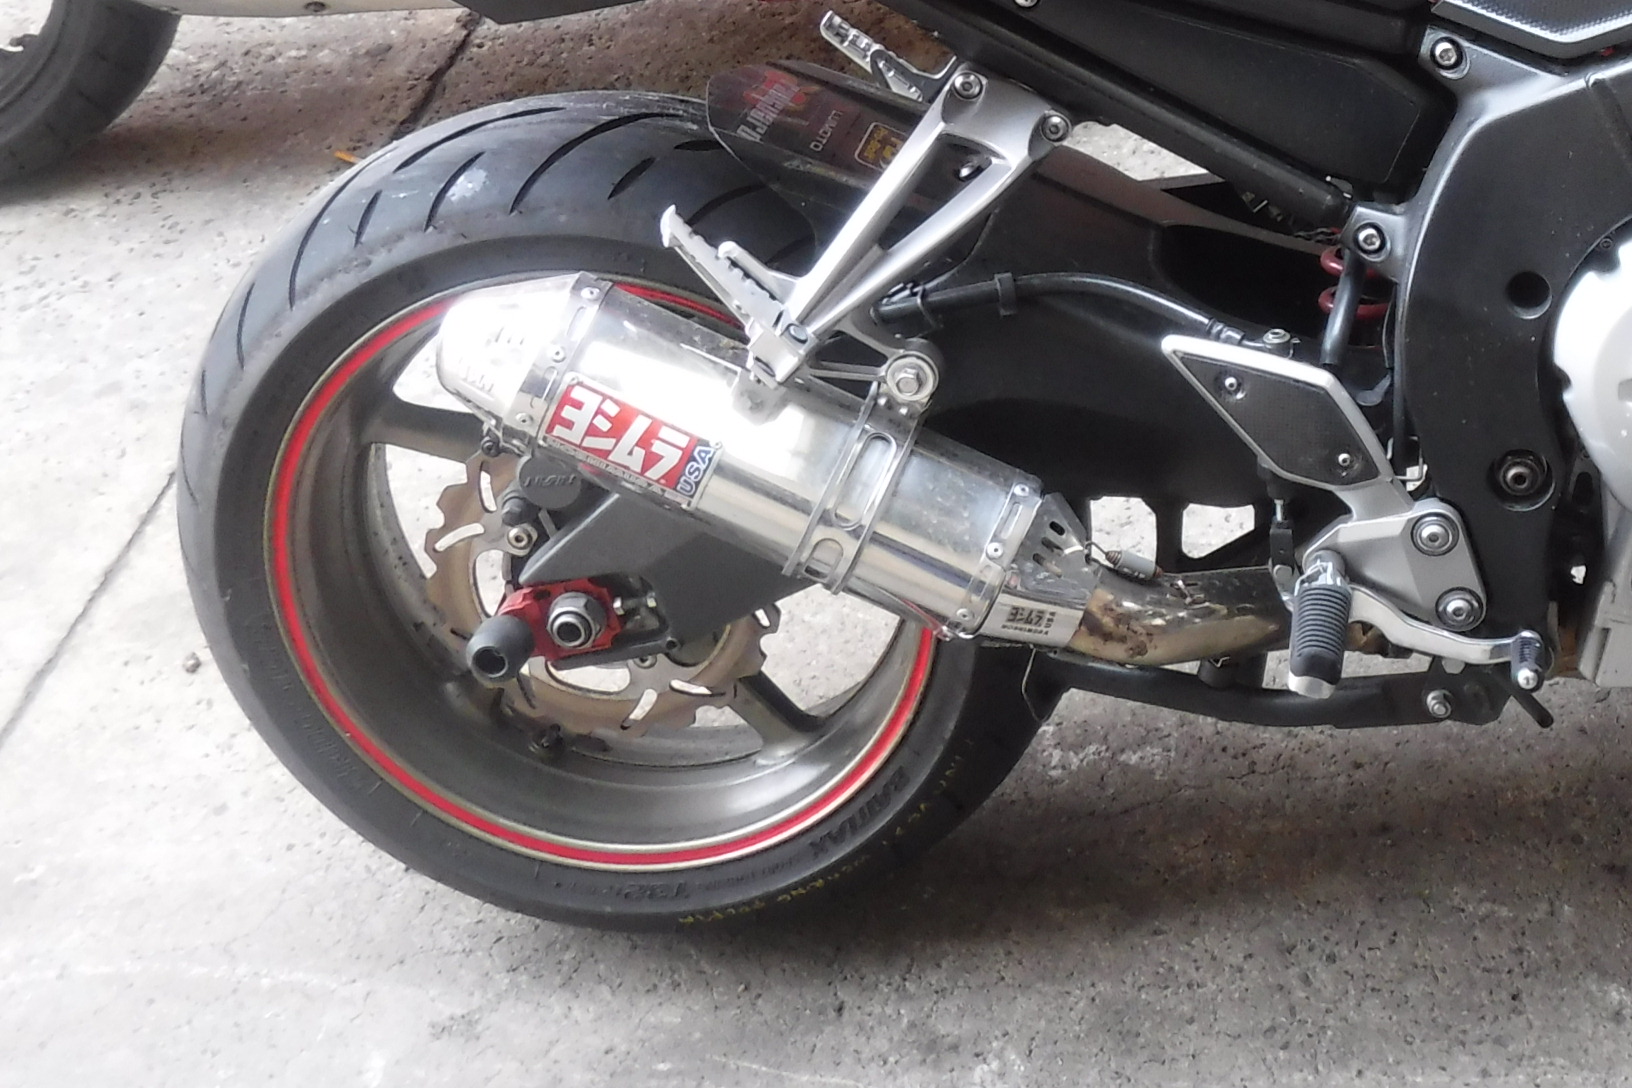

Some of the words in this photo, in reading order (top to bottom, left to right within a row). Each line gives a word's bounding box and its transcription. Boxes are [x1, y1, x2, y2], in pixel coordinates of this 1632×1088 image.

[552, 385, 690, 481] ヨシムラ
[676, 445, 717, 497] USA
